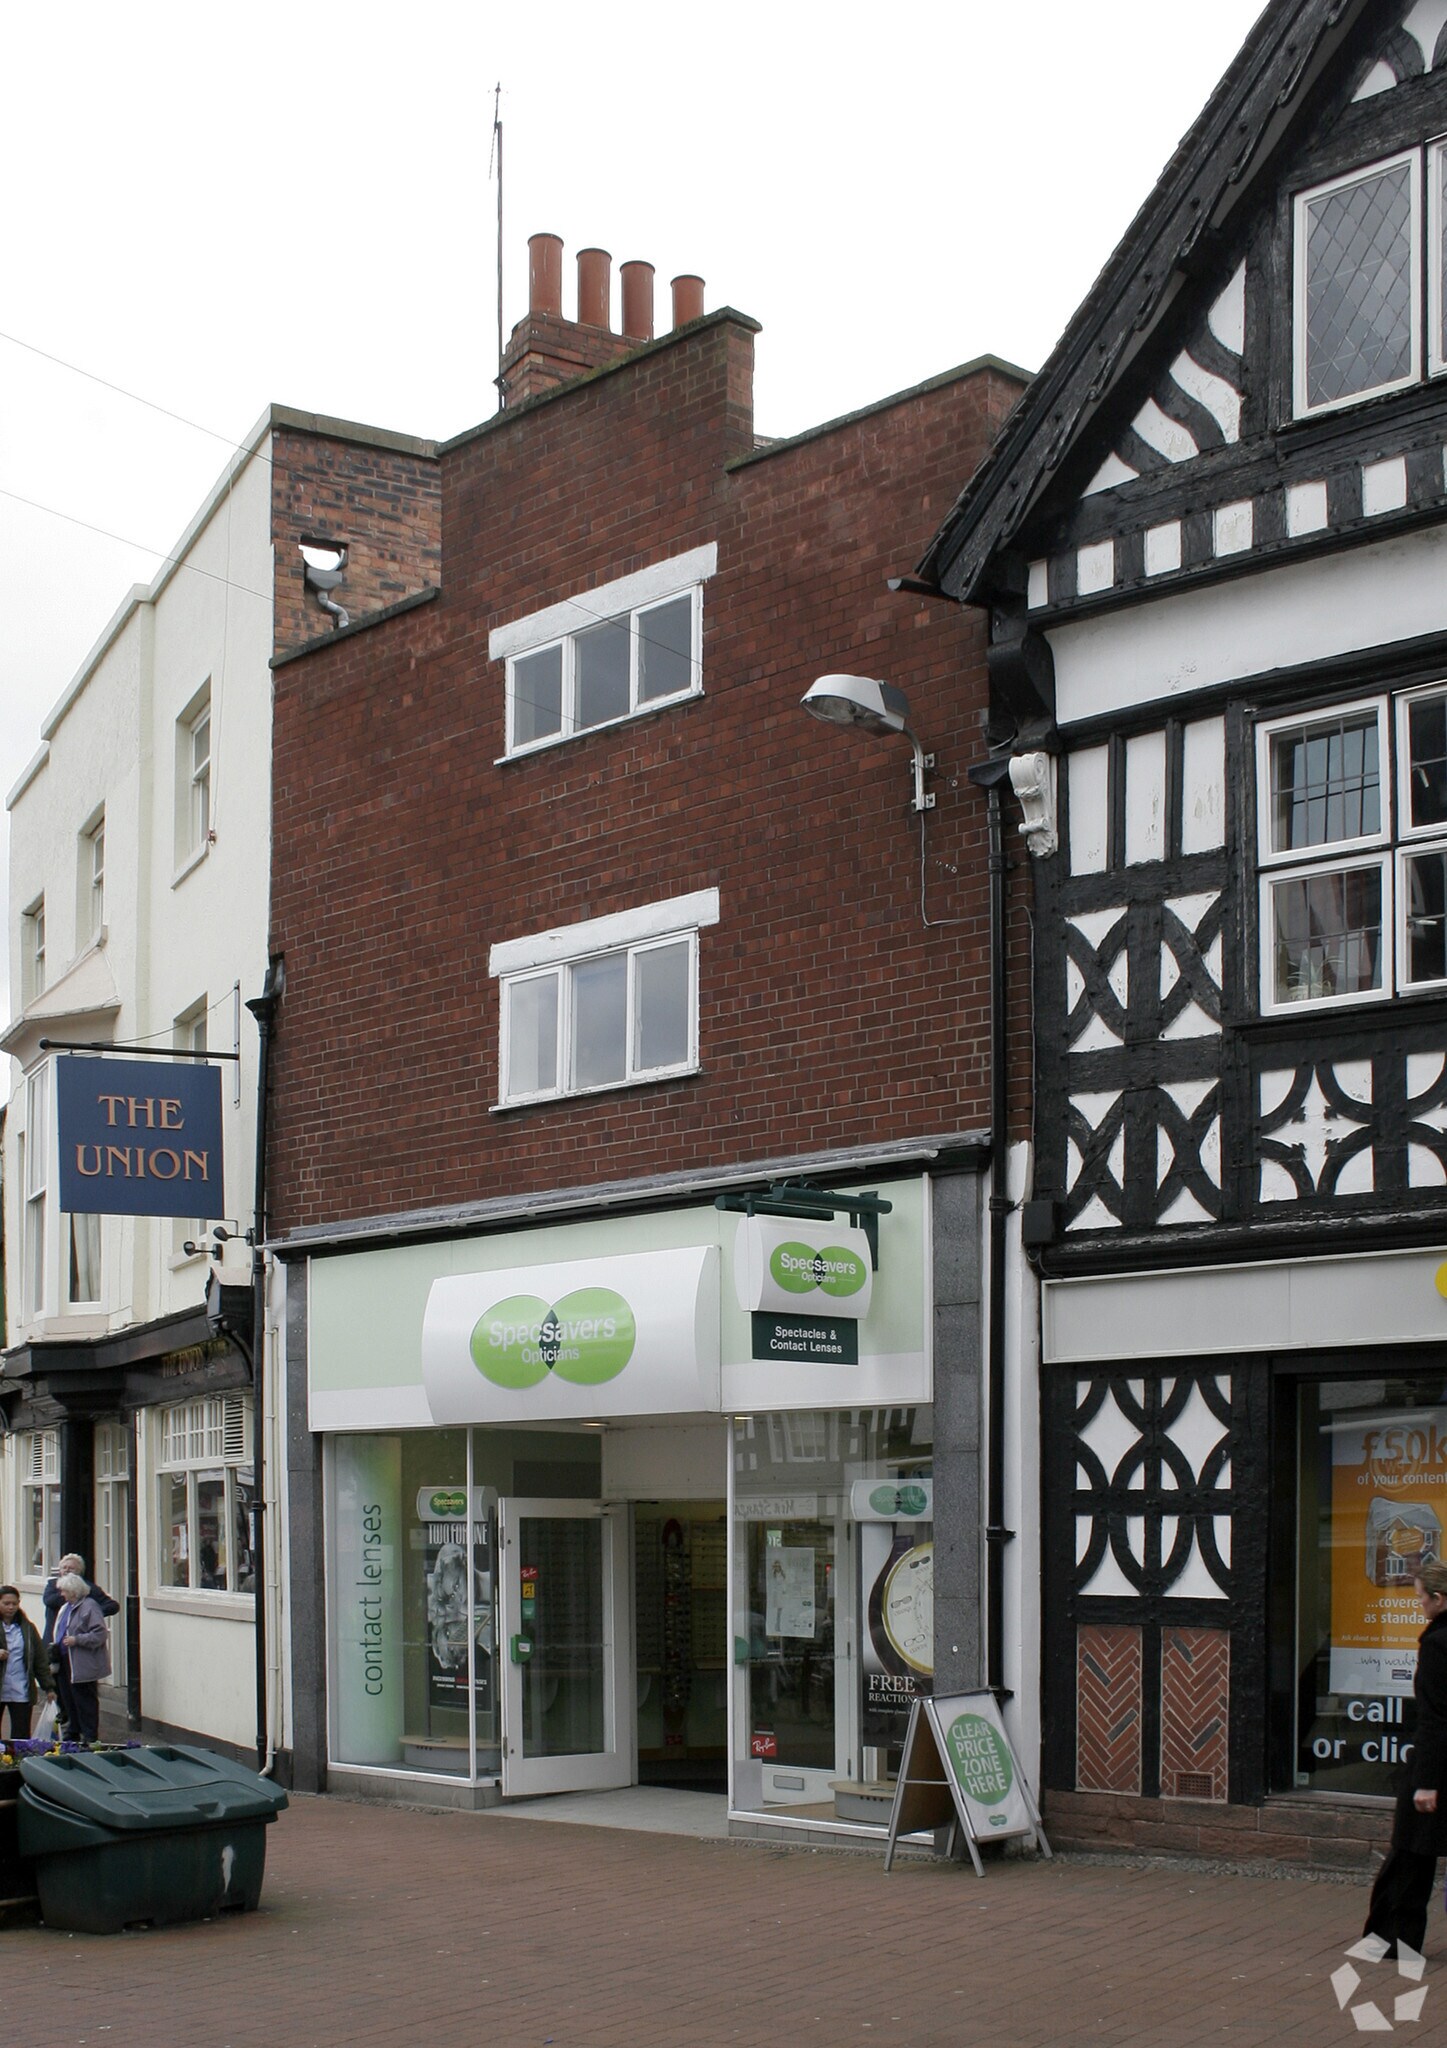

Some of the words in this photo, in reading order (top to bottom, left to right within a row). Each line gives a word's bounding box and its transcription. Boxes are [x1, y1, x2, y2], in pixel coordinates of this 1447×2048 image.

[97, 1095, 185, 1130] THE
[75, 1144, 209, 1181] UNION
[781, 1252, 857, 1275] Specsavers
[801, 1271, 837, 1284] Opticians
[488, 1315, 617, 1352] Specsavers
[775, 1325, 827, 1340] Spectacles
[829, 1329, 837, 1340] &
[521, 1345, 580, 1366] Opticians
[770, 1339, 807, 1352] Contact
[810, 1341, 843, 1354] Lenses
[1361, 1424, 1447, 1464] £50k
[1357, 1472, 1369, 1485] of
[1373, 1474, 1399, 1488] your
[356, 1504, 382, 1586] lenses
[428, 1523, 450, 1545] TWO
[1364, 1613, 1377, 1624] as
[1381, 1611, 1429, 1625] standa
[359, 1596, 384, 1696] contact
[868, 1674, 916, 1693] FREE
[1347, 1697, 1403, 1724] call
[951, 1721, 992, 1740] CLEAR
[955, 1737, 998, 1759] PRICE
[1313, 1737, 1347, 1759] or
[1361, 1736, 1415, 1764] clic
[961, 1754, 1003, 1776] ZONE
[967, 1772, 1008, 1795] HERE
